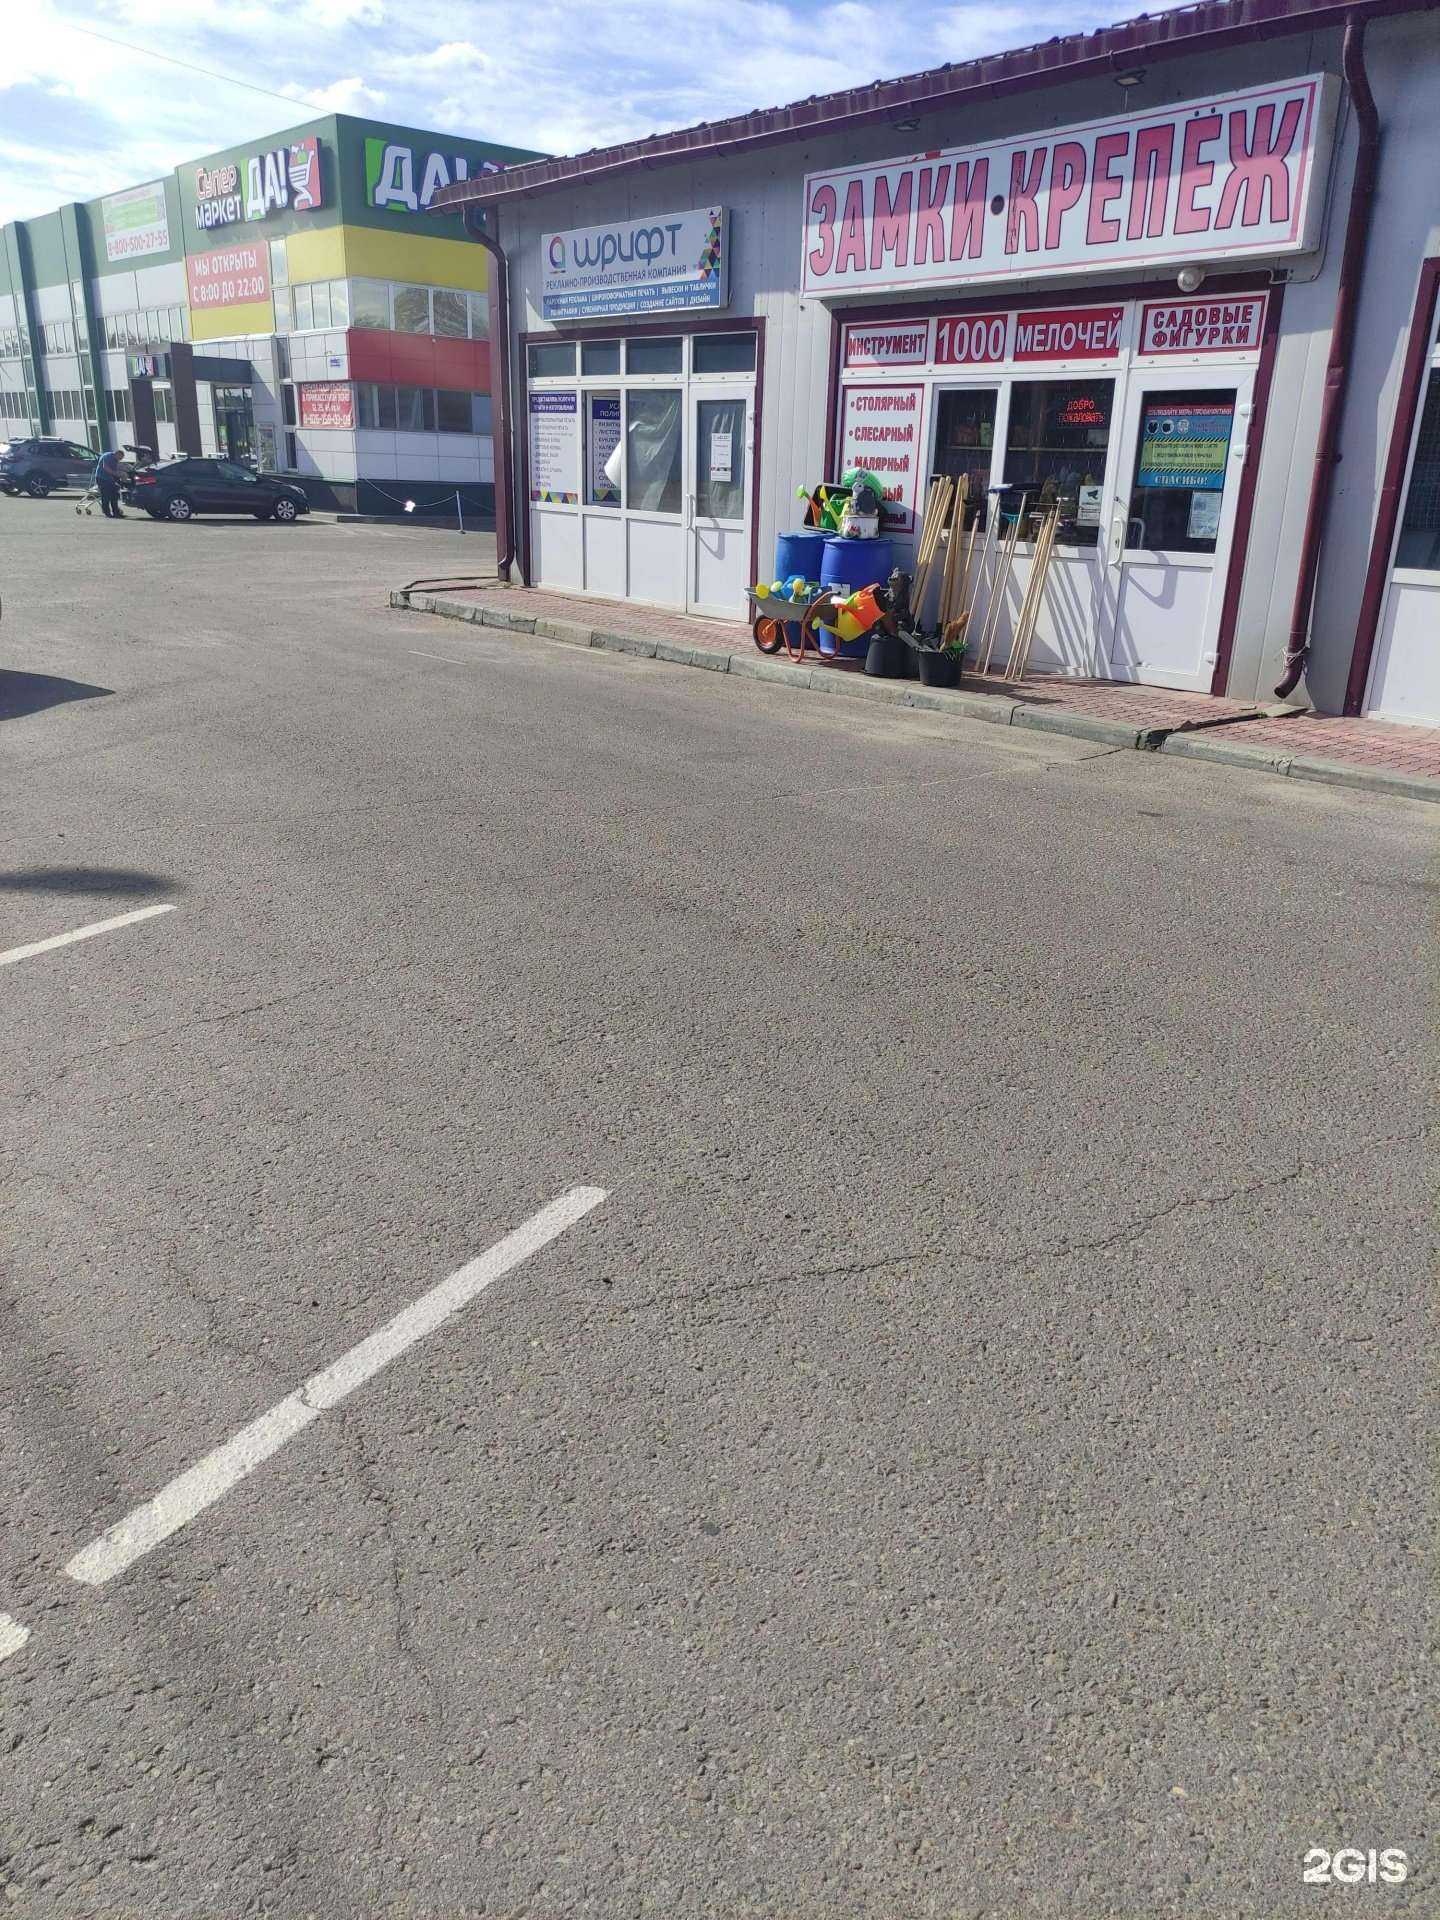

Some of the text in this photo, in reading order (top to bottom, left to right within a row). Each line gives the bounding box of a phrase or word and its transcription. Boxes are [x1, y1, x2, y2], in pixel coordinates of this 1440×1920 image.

[247, 149, 288, 218] ДА!
[809, 98, 1305, 276] ЗАМКИ КРЕПЁЖ
[195, 248, 257, 276] МЫ ОТКРЫТЫ
[648, 264, 687, 280] КОМПАНИЯ
[200, 282, 220, 302] 8:00
[222, 280, 235, 303] ДО
[238, 275, 264, 297] 22:00
[1153, 304, 1253, 329] САДОВЫЕ
[848, 332, 926, 357] ИНСТРУМЕНТ
[938, 311, 1122, 362] 1000 МЕЛОЧЕЙ
[1151, 325, 1249, 347] ФИГУРКИ
[855, 392, 917, 412] СТОЛЯРНЫЙ
[1067, 399, 1095, 411] ДОБРО
[854, 424, 913, 442] СЛЕСАРНЫЙ
[854, 454, 910, 473] МАЛЯРНЫЙ
[1154, 475, 1208, 486] СПАСИБО!
